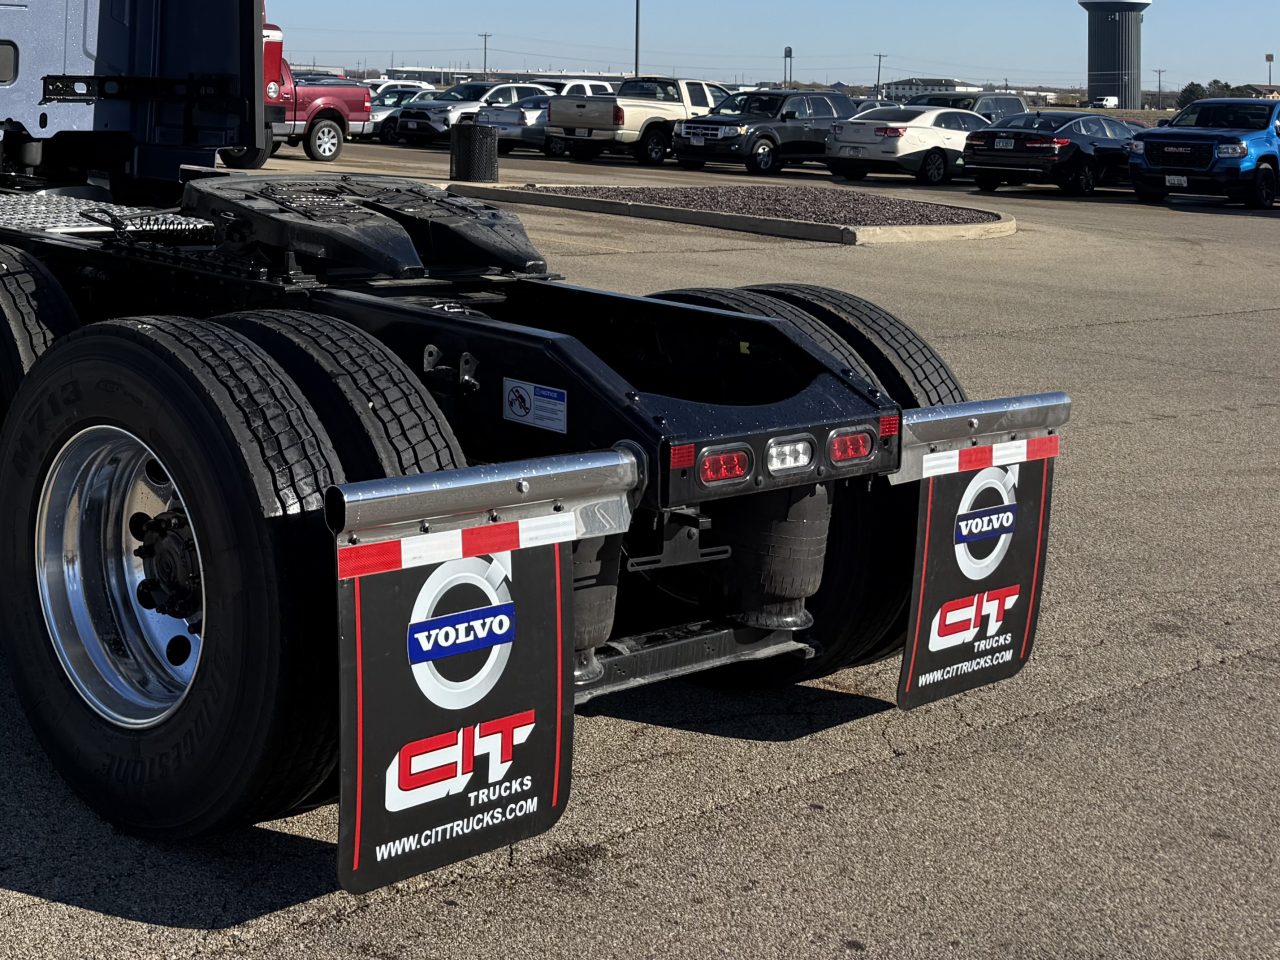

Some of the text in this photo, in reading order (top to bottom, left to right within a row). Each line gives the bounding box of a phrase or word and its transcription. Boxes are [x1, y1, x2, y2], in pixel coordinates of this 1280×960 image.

[958, 511, 1014, 536] VOLVO
[413, 614, 511, 653] VOLVO
[929, 584, 1020, 651] CIT
[973, 632, 1012, 654] TRUCKS
[918, 649, 1014, 687] WWW.CITTRUCKS.COM
[387, 709, 535, 810] CIT
[467, 775, 532, 807] TRUCKS
[375, 796, 538, 862] WWW.CITTRUCKS.COM
